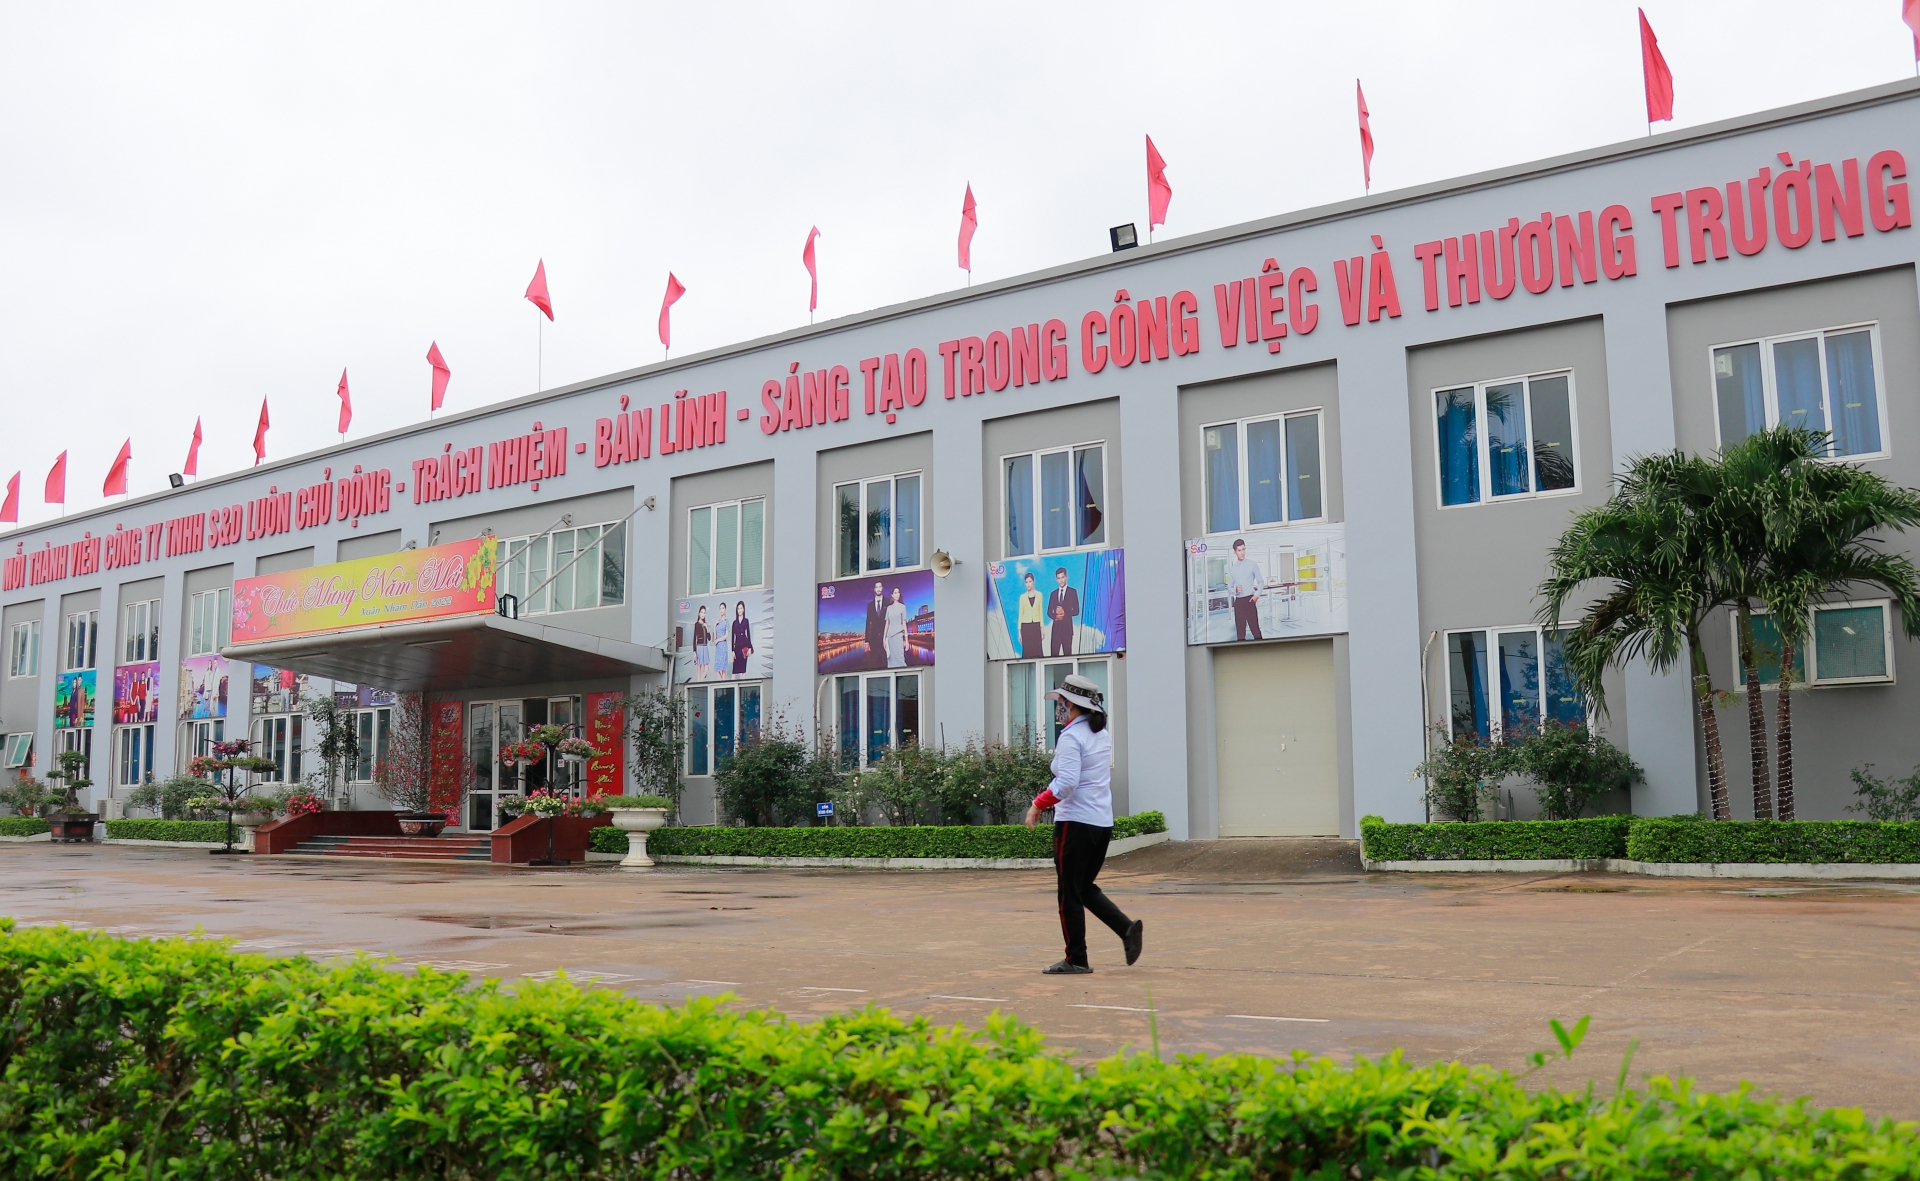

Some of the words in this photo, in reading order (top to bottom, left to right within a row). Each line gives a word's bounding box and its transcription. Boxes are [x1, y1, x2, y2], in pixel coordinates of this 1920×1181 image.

[29, 541, 70, 586] THÀNH
[70, 531, 101, 577] VIÊN
[103, 523, 142, 570] CÔNG
[145, 523, 163, 561] TY
[165, 513, 205, 557] TNHH
[208, 504, 243, 549] S&D
[246, 486, 292, 540] LUÔN
[295, 467, 333, 530] CHỦ
[336, 464, 391, 528] ĐỘNG
[412, 443, 483, 504] TRÁCH
[486, 422, 567, 491] NHIỆM
[595, 394, 652, 468] BẢN
[659, 390, 726, 455] LĨNH
[760, 362, 849, 435] SÁNG
[860, 347, 927, 424] TẠO
[938, 318, 1068, 399] TRONG
[1080, 289, 1200, 374] CÔNG
[1213, 258, 1319, 354] VIỆC
[1333, 235, 1403, 325] VÀ
[1414, 204, 1637, 310] THƯƠNG
[1651, 150, 1912, 269] TRƯỜNG
[1190, 543, 1207, 554] S&D
[989, 564, 1005, 575] S&D
[260, 584, 298, 617] Chúc
[301, 575, 357, 617] Mừng
[361, 565, 413, 602] Năm
[417, 554, 464, 593] Mới
[360, 606, 380, 617] Xuân
[430, 596, 453, 608] 2022
